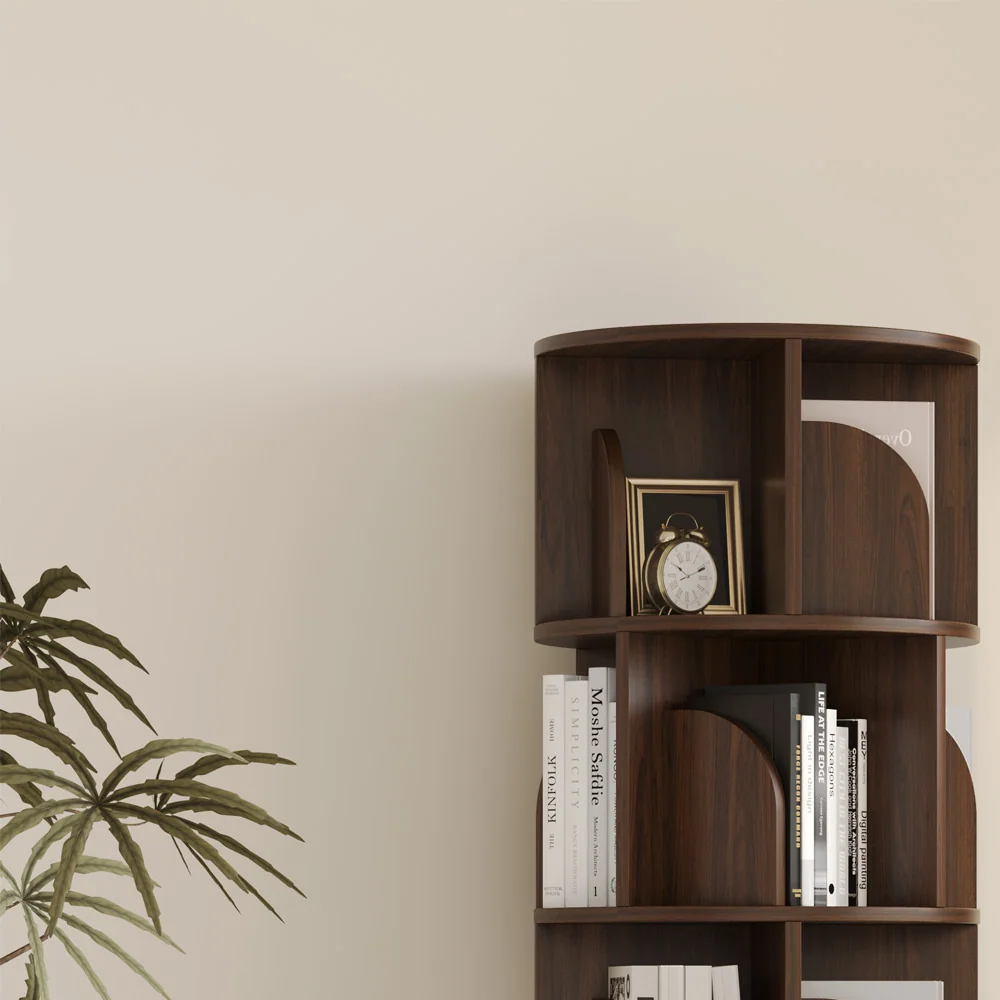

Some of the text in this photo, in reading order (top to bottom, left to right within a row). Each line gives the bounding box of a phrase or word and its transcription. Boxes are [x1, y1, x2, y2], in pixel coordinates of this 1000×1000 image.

[571, 697, 580, 810] SIMPLICITY
[591, 688, 604, 806] Moshe Safdie
[818, 715, 825, 730] AT
[547, 756, 557, 824] KINFOLK
[828, 733, 836, 797] Hexagons
[859, 811, 867, 890] Digital painting
